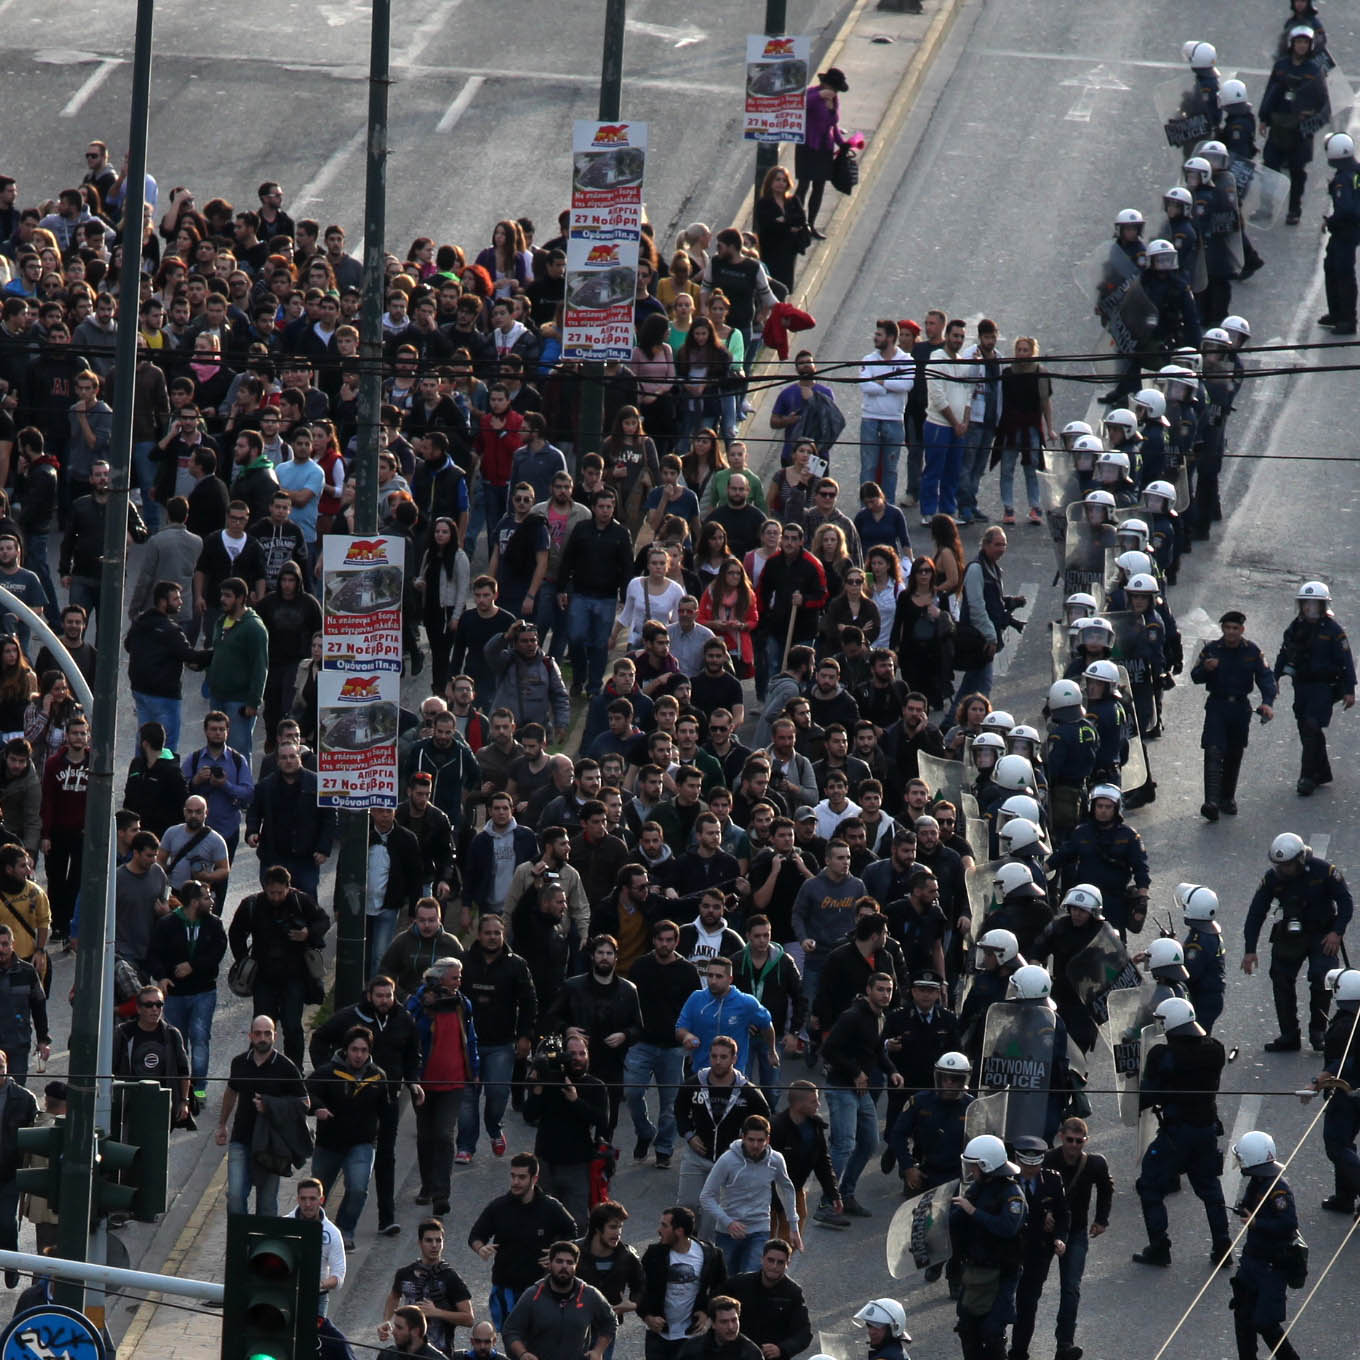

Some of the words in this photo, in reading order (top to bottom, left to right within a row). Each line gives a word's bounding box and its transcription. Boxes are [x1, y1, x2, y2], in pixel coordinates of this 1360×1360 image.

[748, 118, 759, 127] 27
[575, 215, 588, 223] 27
[568, 333, 581, 342] 27
[327, 642, 342, 653] 27
[322, 778, 337, 789] 27
[984, 1072, 1041, 1089] POLICE
[15, 1326, 94, 1350] FUCK
